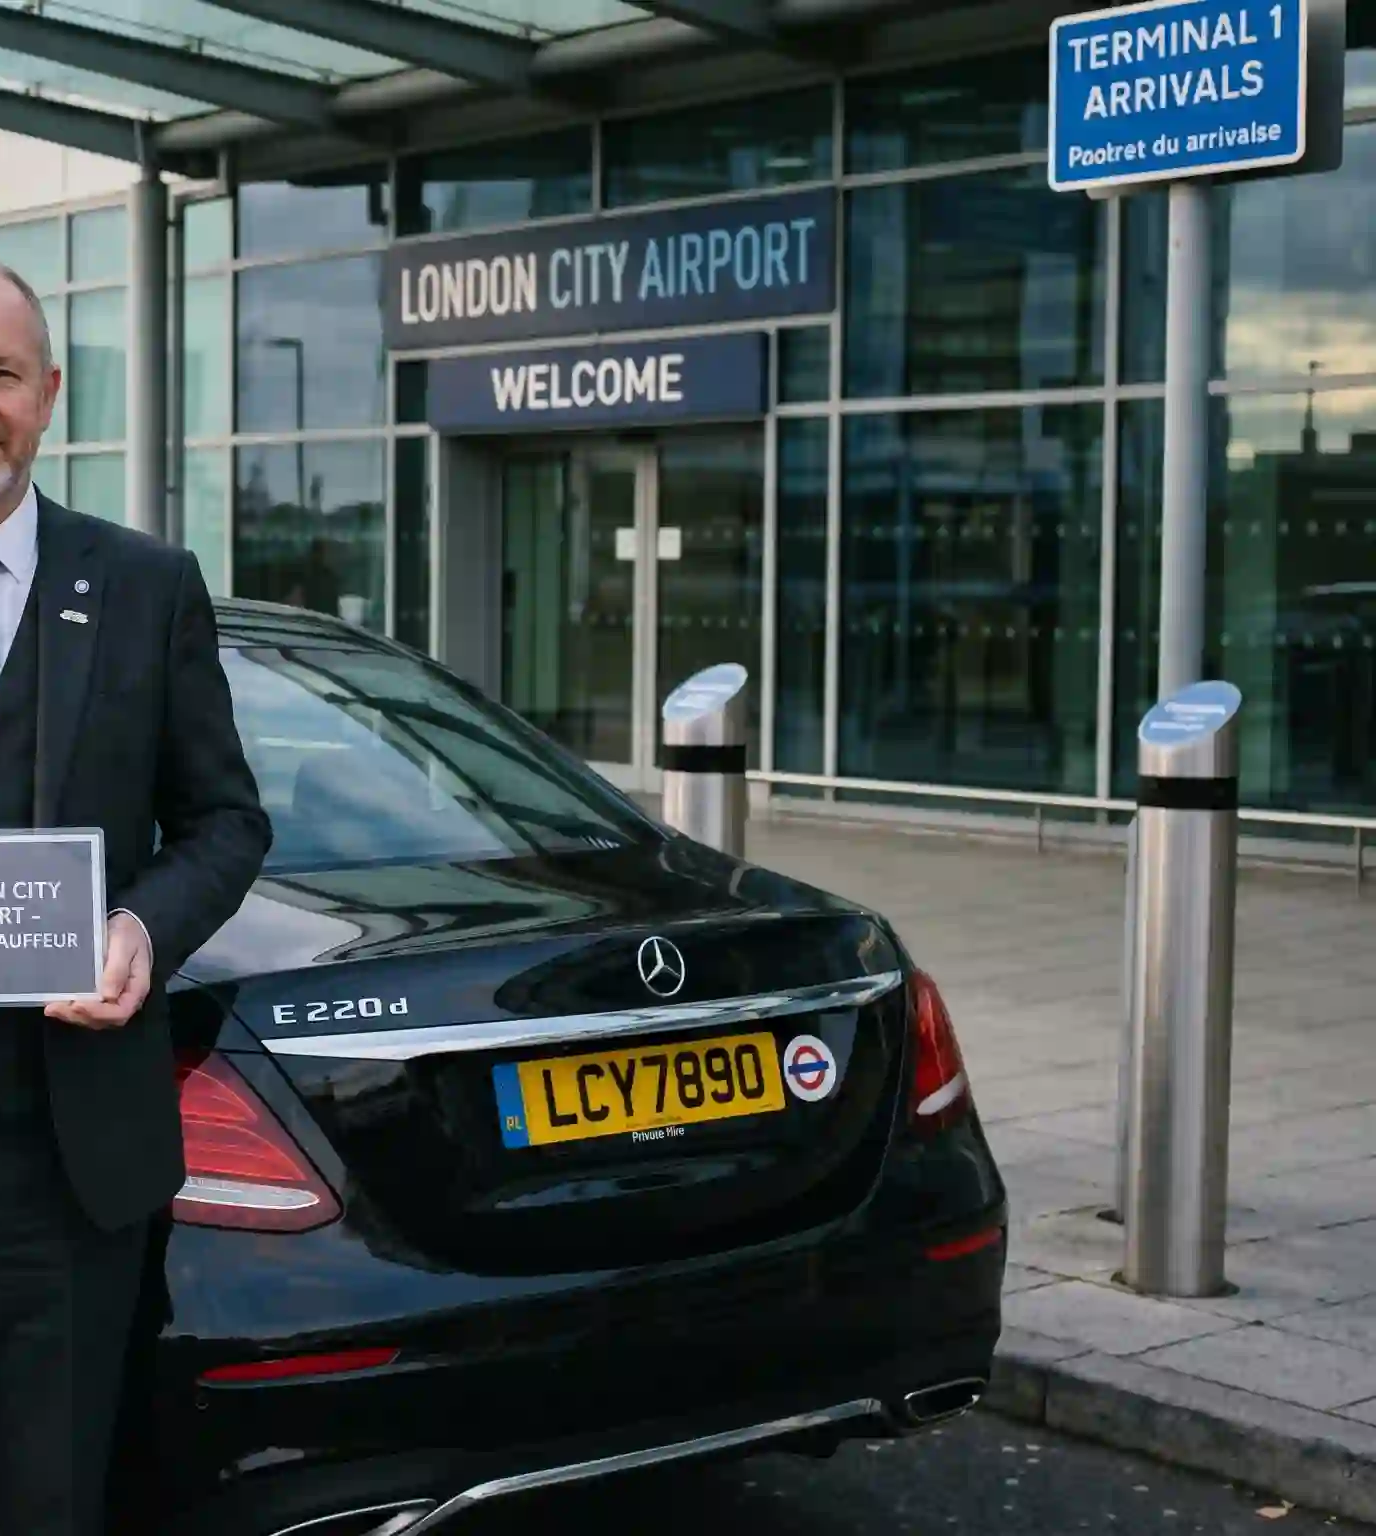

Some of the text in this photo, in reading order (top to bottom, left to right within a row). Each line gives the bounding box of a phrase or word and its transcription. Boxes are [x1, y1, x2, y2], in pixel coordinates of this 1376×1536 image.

[1068, 4, 1282, 73] TERMINAL 1
[1083, 60, 1264, 121] ARRIVALS
[1152, 134, 1179, 155] du
[1186, 121, 1282, 152] arrivalse
[401, 218, 816, 324] LONDON CITY AIRPORT
[492, 353, 685, 412] WELCOME
[13, 881, 62, 899] CITY
[272, 997, 408, 1024] E 220 d
[541, 1043, 765, 1127] LCY7890
